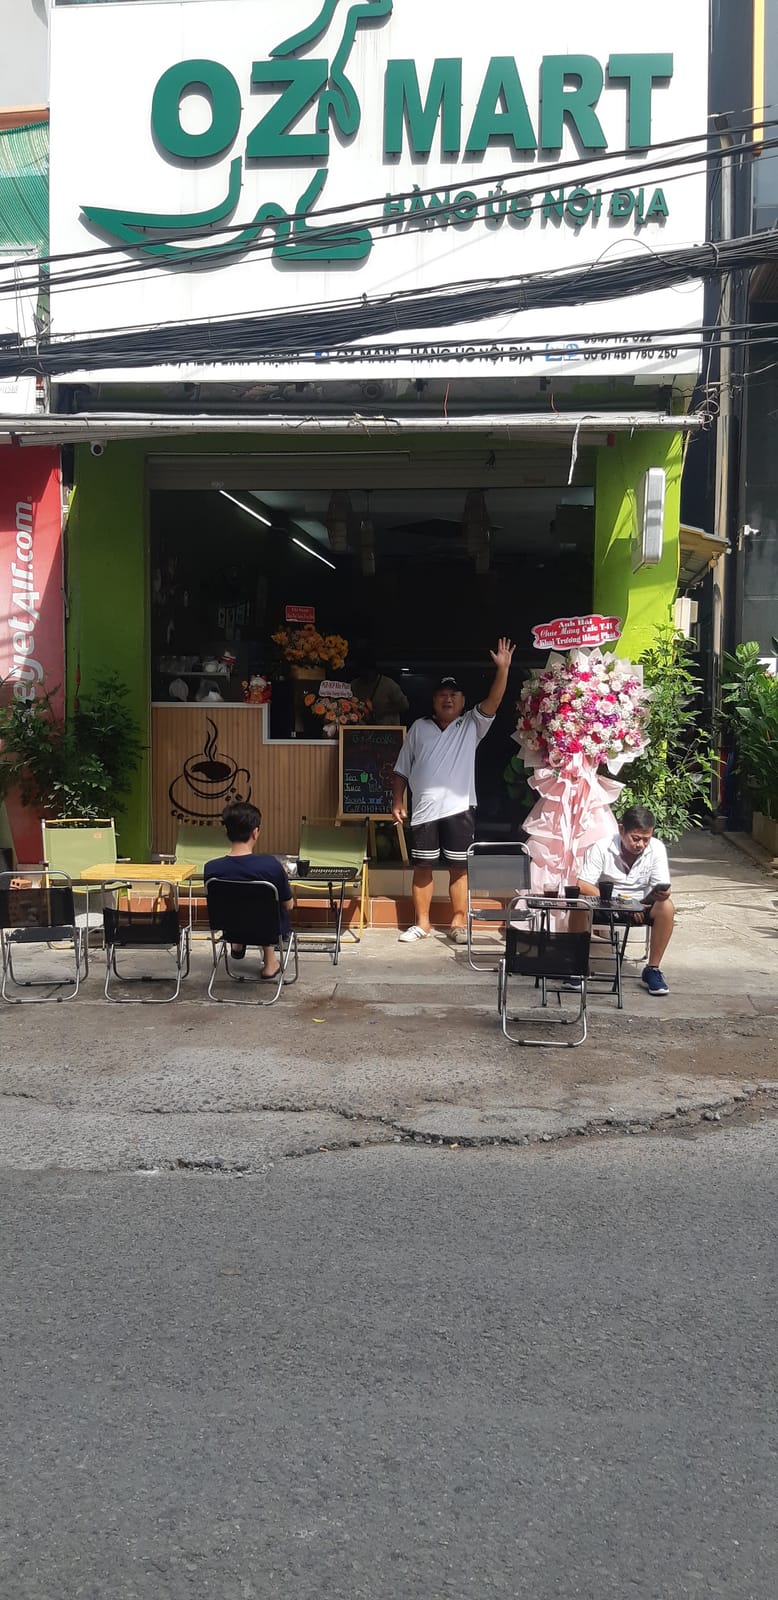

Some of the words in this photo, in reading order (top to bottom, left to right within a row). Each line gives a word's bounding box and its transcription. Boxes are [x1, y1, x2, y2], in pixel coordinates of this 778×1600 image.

[150, 59, 330, 160] OZ
[384, 53, 674, 153] MART
[543, 184, 602, 226] NỘI
[611, 187, 670, 225] ĐỊA
